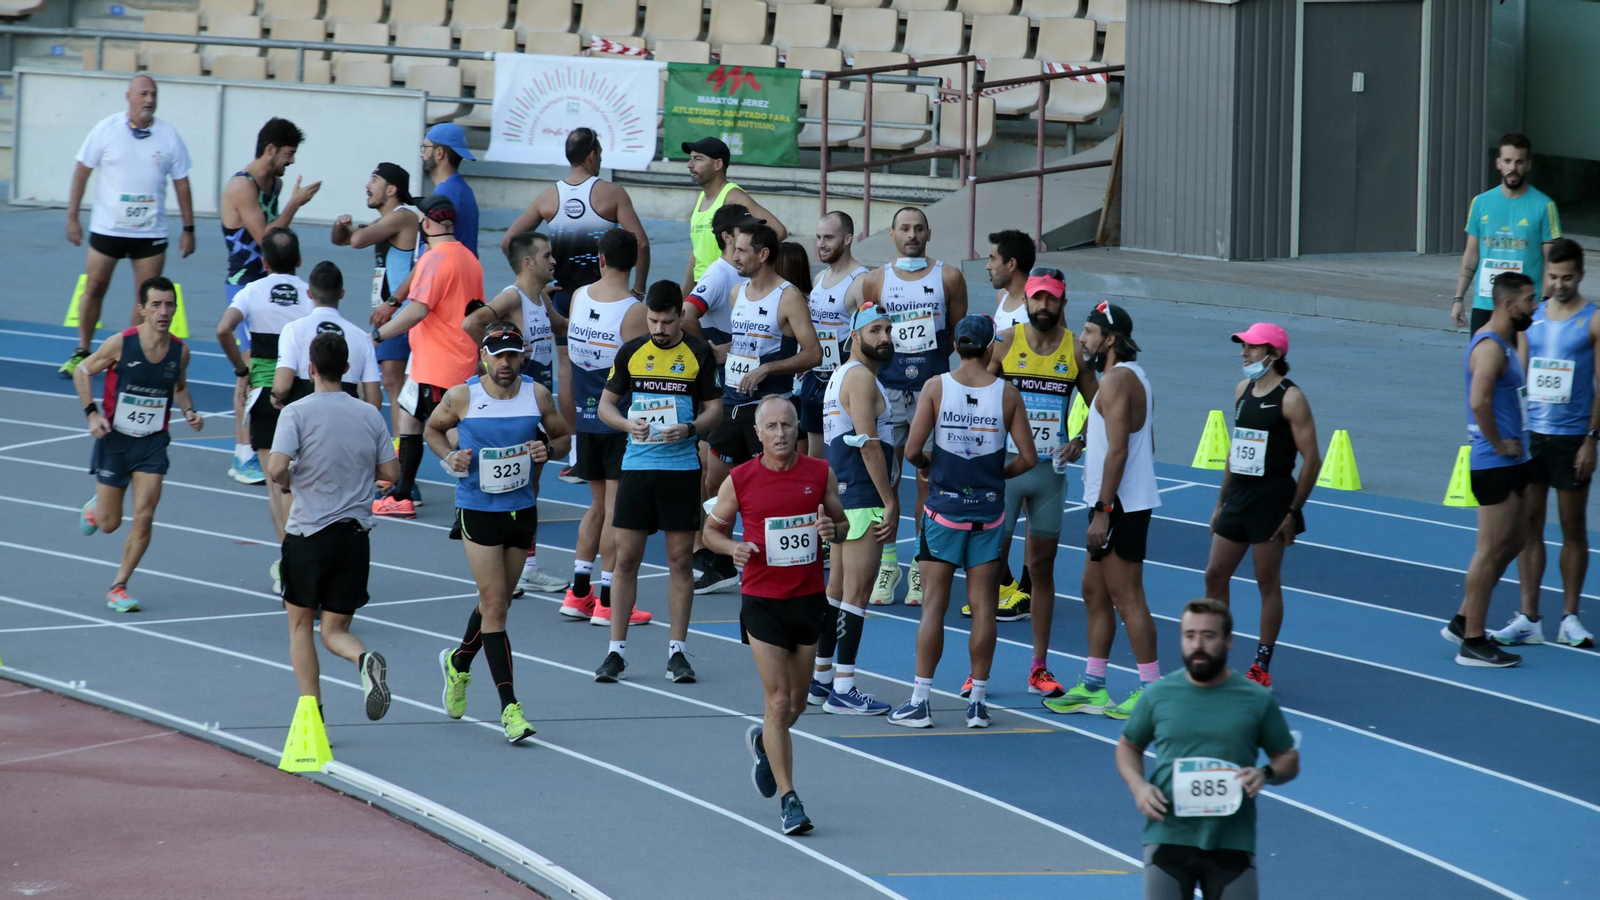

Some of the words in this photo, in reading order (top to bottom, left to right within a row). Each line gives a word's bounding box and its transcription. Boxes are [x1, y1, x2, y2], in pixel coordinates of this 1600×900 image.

[697, 95, 739, 105] MARATÓN
[740, 98, 770, 108] JEREZ
[672, 106, 721, 117] ATLETISMO
[723, 109, 767, 120] ADAPTADO
[769, 113, 791, 123] PARA
[688, 117, 715, 127] NIÑOS
[717, 119, 734, 127] CON
[737, 121, 776, 131] AUTISMO
[125, 206, 149, 218] 607
[898, 324, 926, 341] 872
[643, 381, 688, 392] MOVIJEREZ
[1021, 379, 1068, 393] MOVIJEREZ
[1537, 374, 1562, 389] 668
[127, 410, 156, 425] 457
[943, 411, 998, 426] Movijerez
[1032, 426, 1050, 441] 75
[1236, 445, 1256, 460] 159
[493, 462, 521, 479] 323
[779, 533, 810, 551] 936
[1190, 779, 1228, 797] 885
